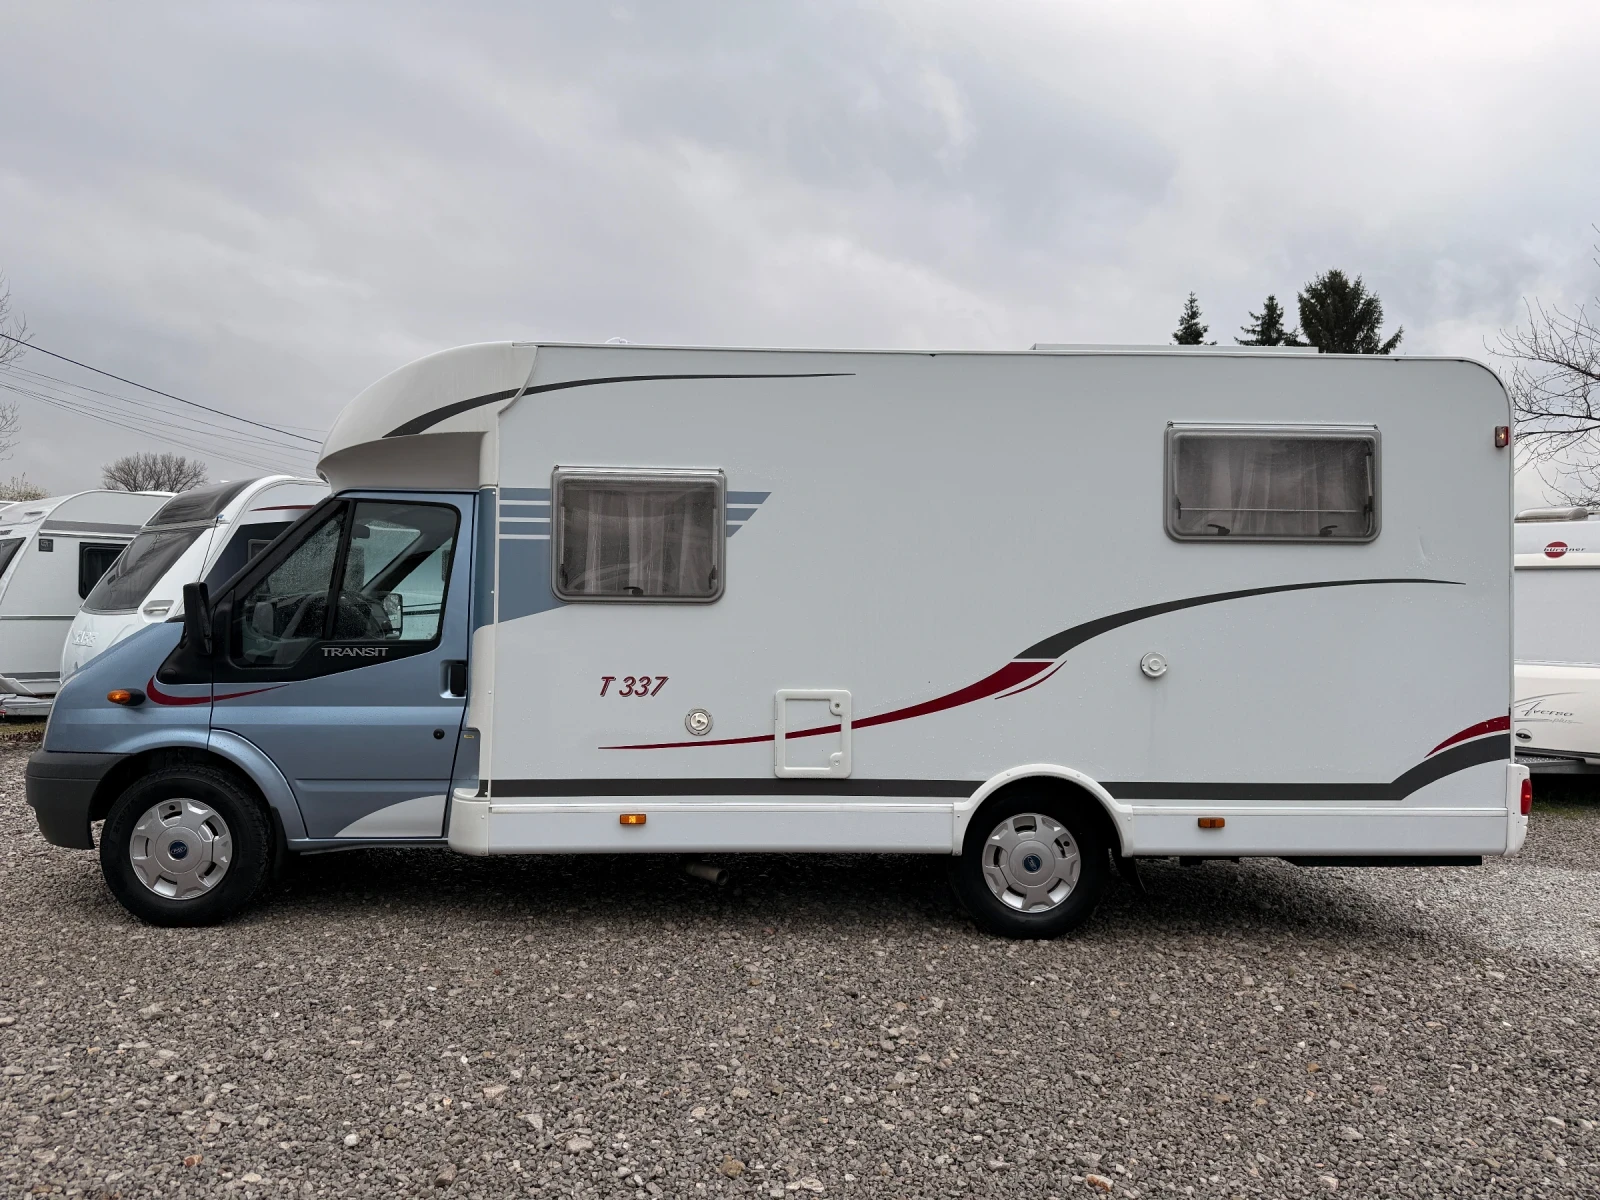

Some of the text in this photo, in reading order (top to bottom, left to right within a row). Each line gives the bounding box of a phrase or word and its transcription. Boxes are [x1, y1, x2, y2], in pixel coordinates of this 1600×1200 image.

[321, 647, 389, 657] TRANSIT
[600, 676, 669, 697] T 337
